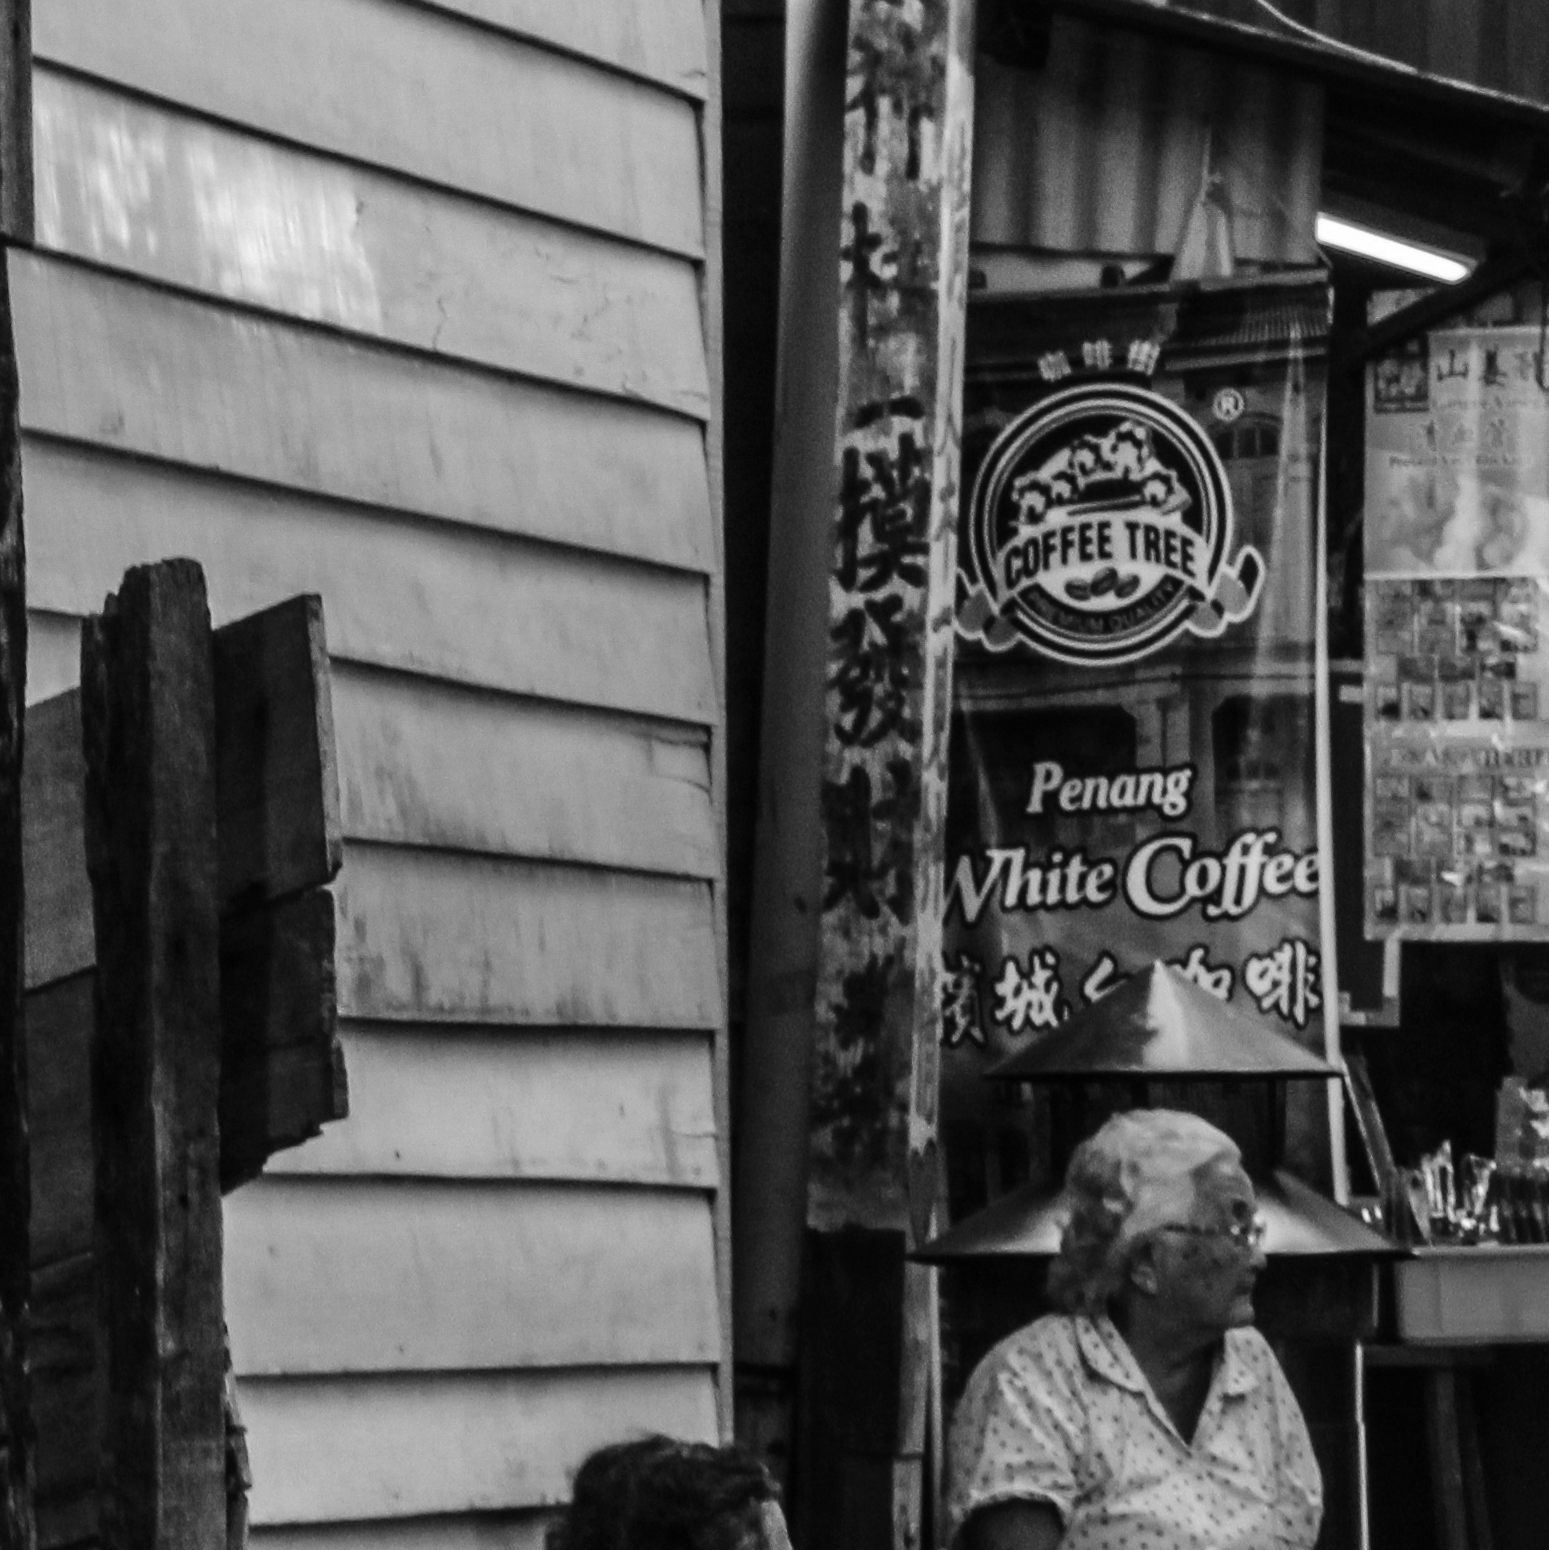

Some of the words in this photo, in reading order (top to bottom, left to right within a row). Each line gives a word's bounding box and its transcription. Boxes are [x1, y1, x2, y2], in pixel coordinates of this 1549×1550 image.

[1004, 521, 1112, 591] COFFEE
[1122, 521, 1196, 577] TREE
[1026, 760, 1193, 817] Penang
[944, 846, 1116, 925] White
[1126, 831, 1319, 917] Coffee
